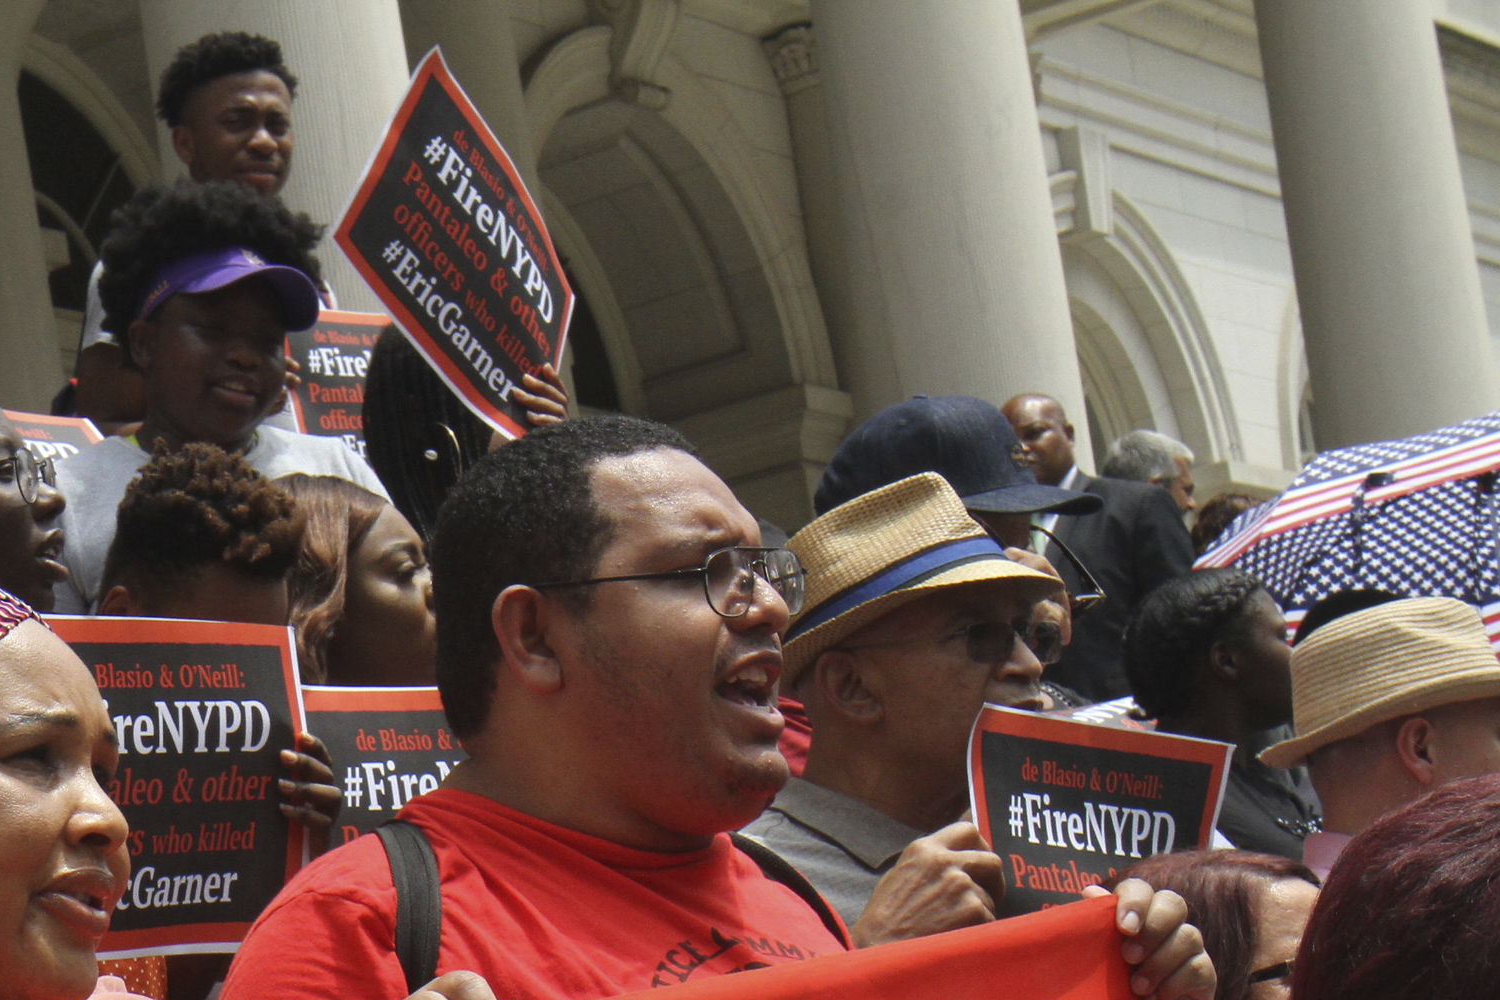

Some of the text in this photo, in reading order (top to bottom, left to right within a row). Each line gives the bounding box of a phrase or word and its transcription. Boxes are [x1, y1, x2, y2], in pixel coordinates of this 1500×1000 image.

[469, 147, 505, 200] Blasio
[423, 135, 553, 323] #FireNYPD
[403, 160, 550, 357] Pantaleo & other
[393, 204, 543, 378] officers who killed
[381, 239, 518, 402] #EricGarner
[308, 347, 372, 377] #Fire
[94, 663, 154, 688] Blasio
[160, 664, 175, 688] &
[102, 699, 271, 755] reNYPD
[356, 728, 453, 751] de Blasio &
[172, 768, 194, 803] &
[202, 765, 272, 802] other
[344, 759, 461, 811] #Fire
[1022, 757, 1038, 782] de
[1043, 760, 1086, 790] Blasio
[1090, 769, 1102, 792] &
[152, 824, 194, 854] who
[197, 821, 257, 852] killed
[1008, 792, 1176, 858] #FireNYPD
